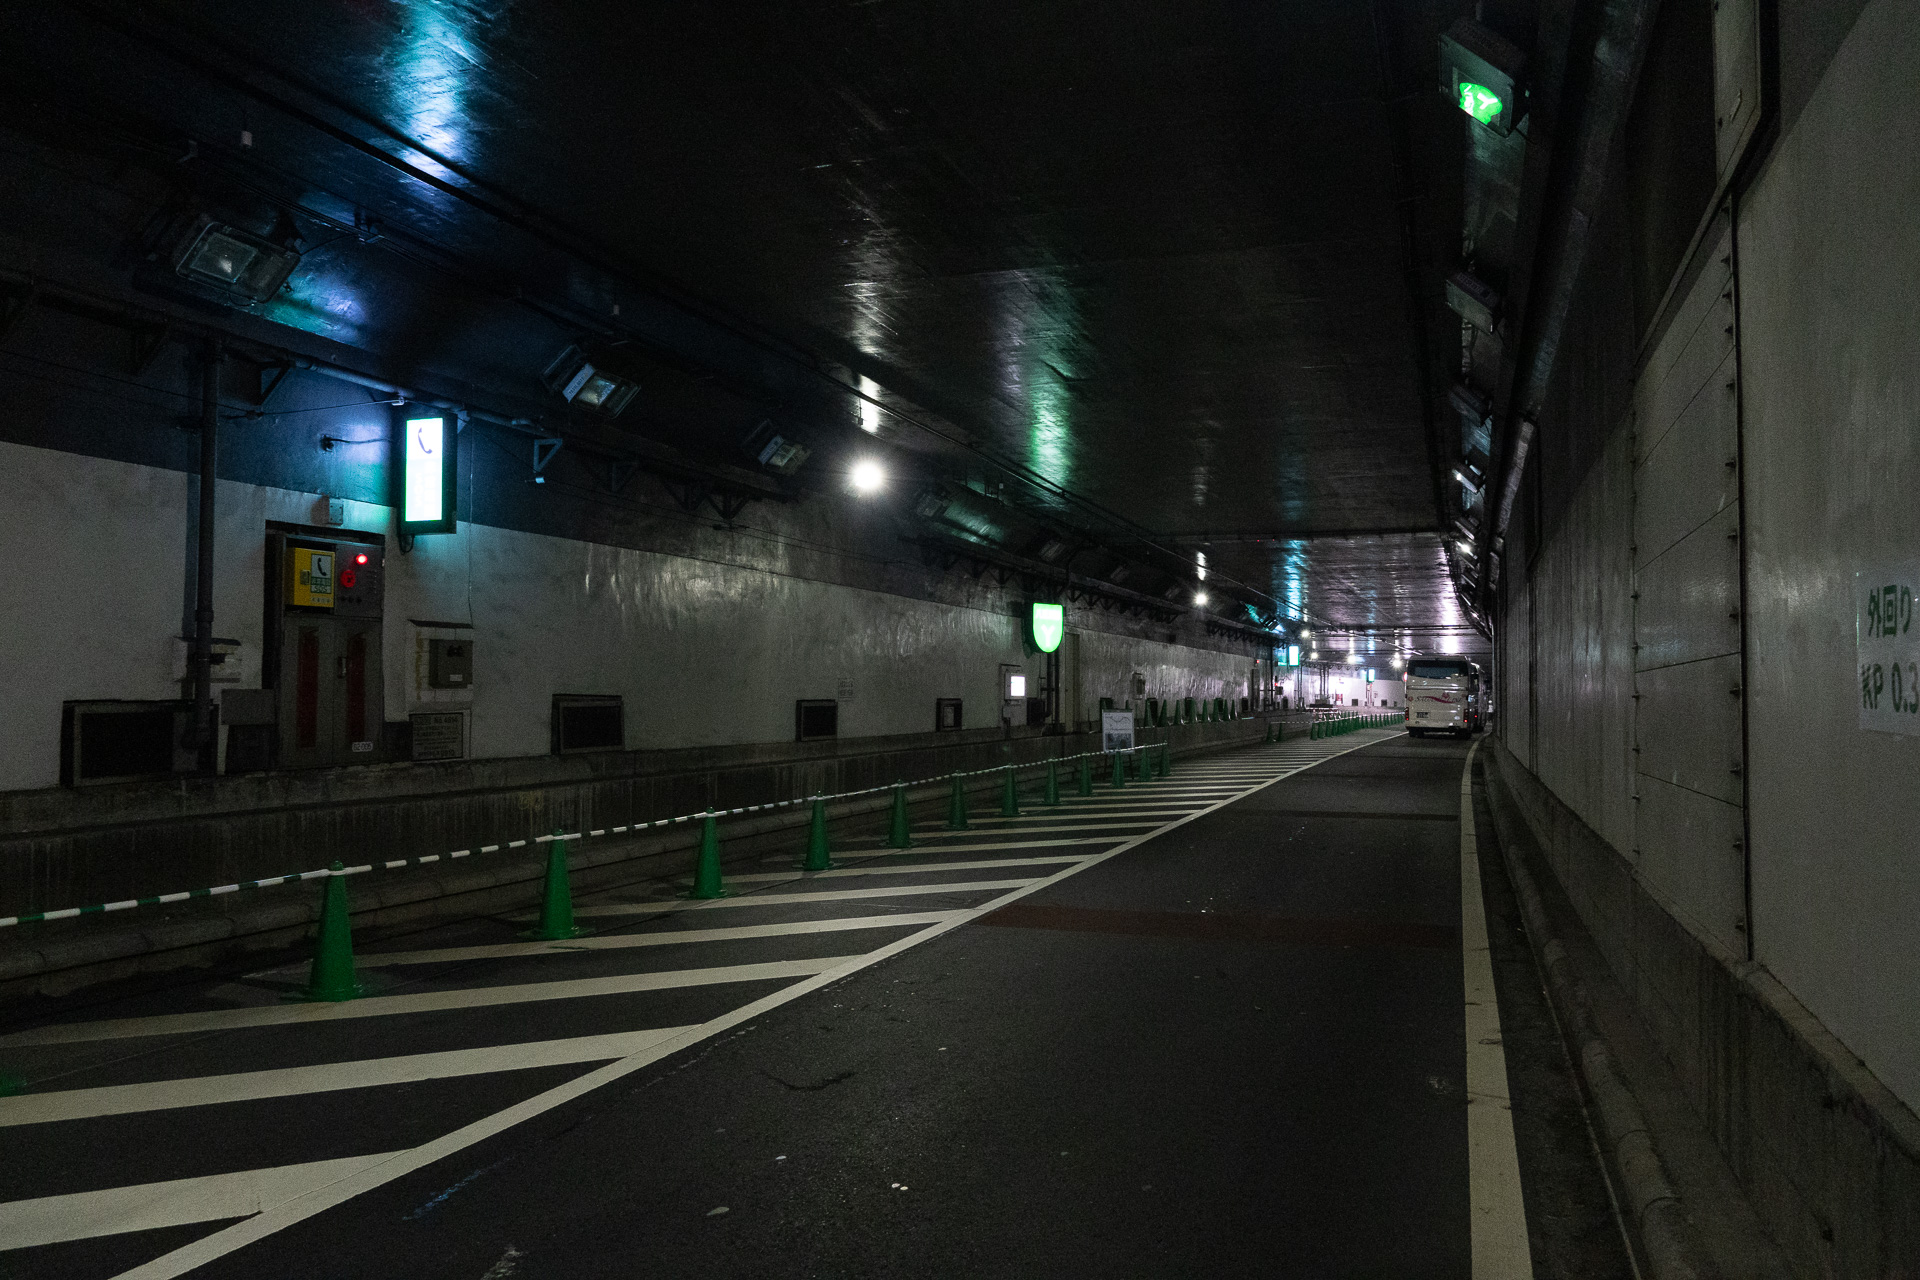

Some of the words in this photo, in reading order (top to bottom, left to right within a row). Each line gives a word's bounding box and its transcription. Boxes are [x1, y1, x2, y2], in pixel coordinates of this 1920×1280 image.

[1041, 624, 1055, 647] Y
[1868, 585, 1911, 638] 外回り
[1892, 662, 1919, 714] 0.3
